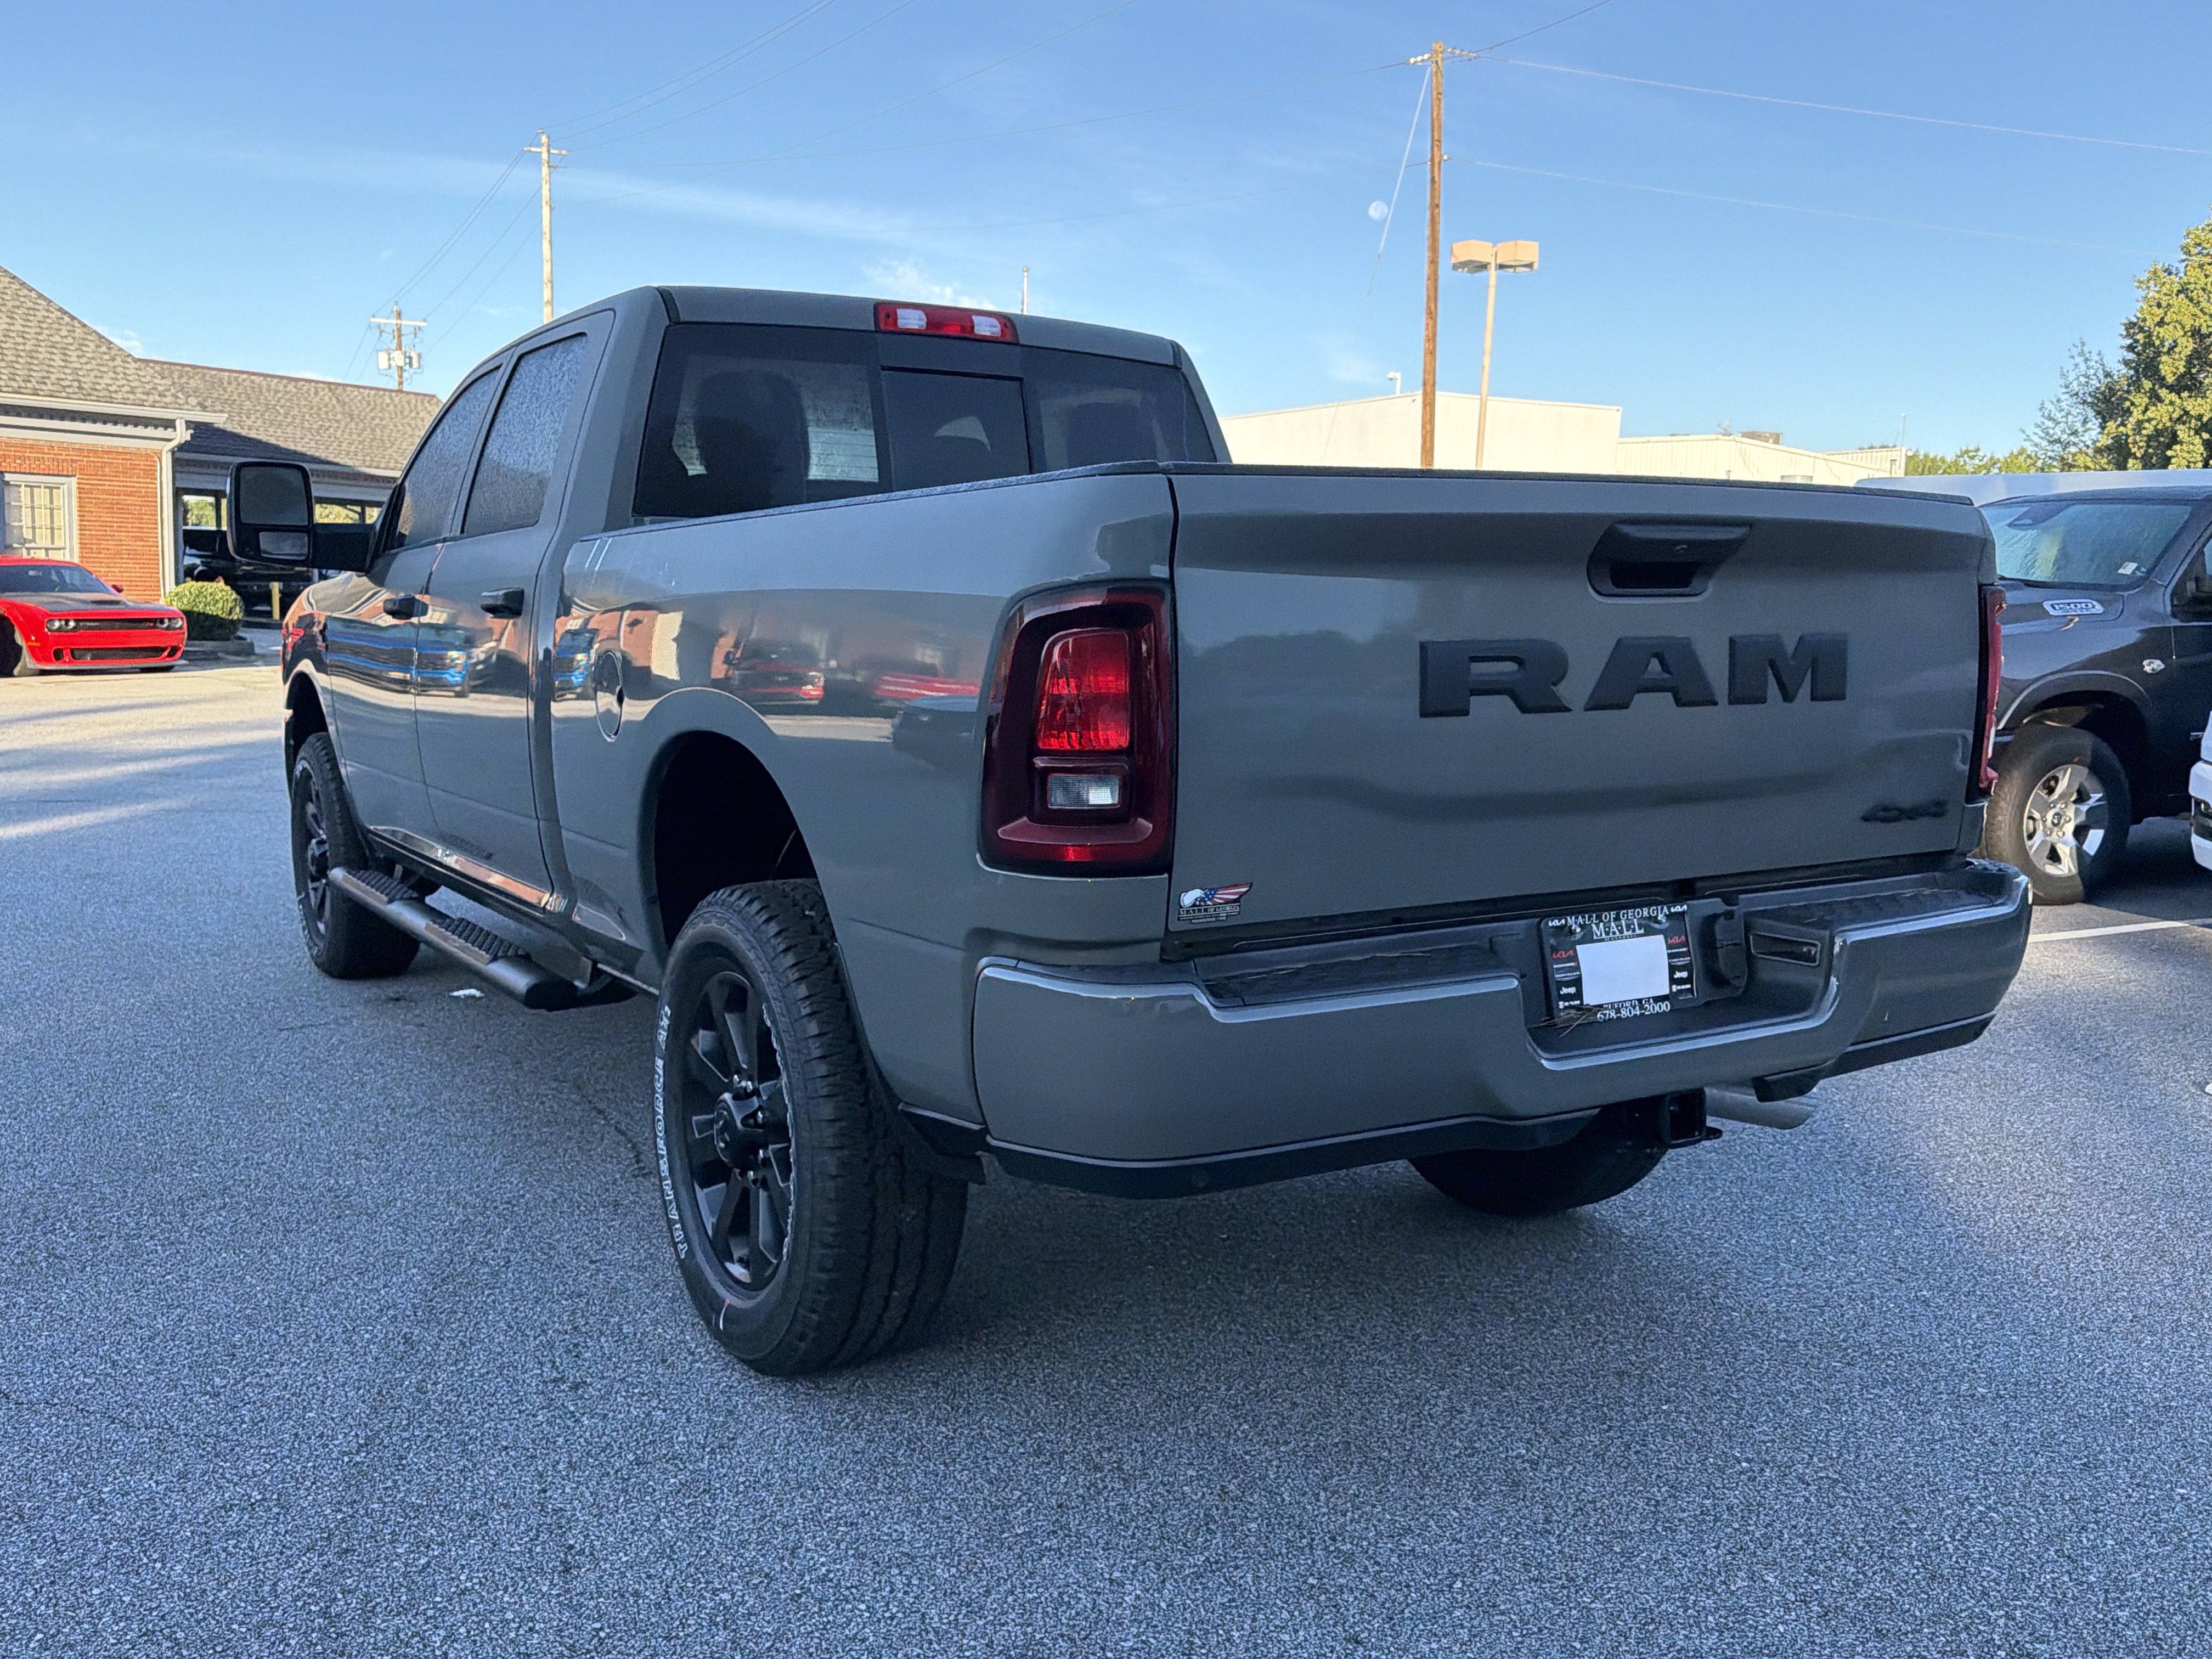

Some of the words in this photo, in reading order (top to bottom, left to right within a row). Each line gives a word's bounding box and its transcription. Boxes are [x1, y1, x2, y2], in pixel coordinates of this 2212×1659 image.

[1419, 633, 1849, 718] RAM
[1602, 911, 1616, 922] OF
[1620, 906, 1669, 920] GEORGIA
[1674, 970, 1688, 979] Jeep
[1560, 986, 1576, 995] Jeep
[1596, 1001, 1671, 1022] 678-804-2000
[654, 1056, 689, 1260] TRANSFORCE
